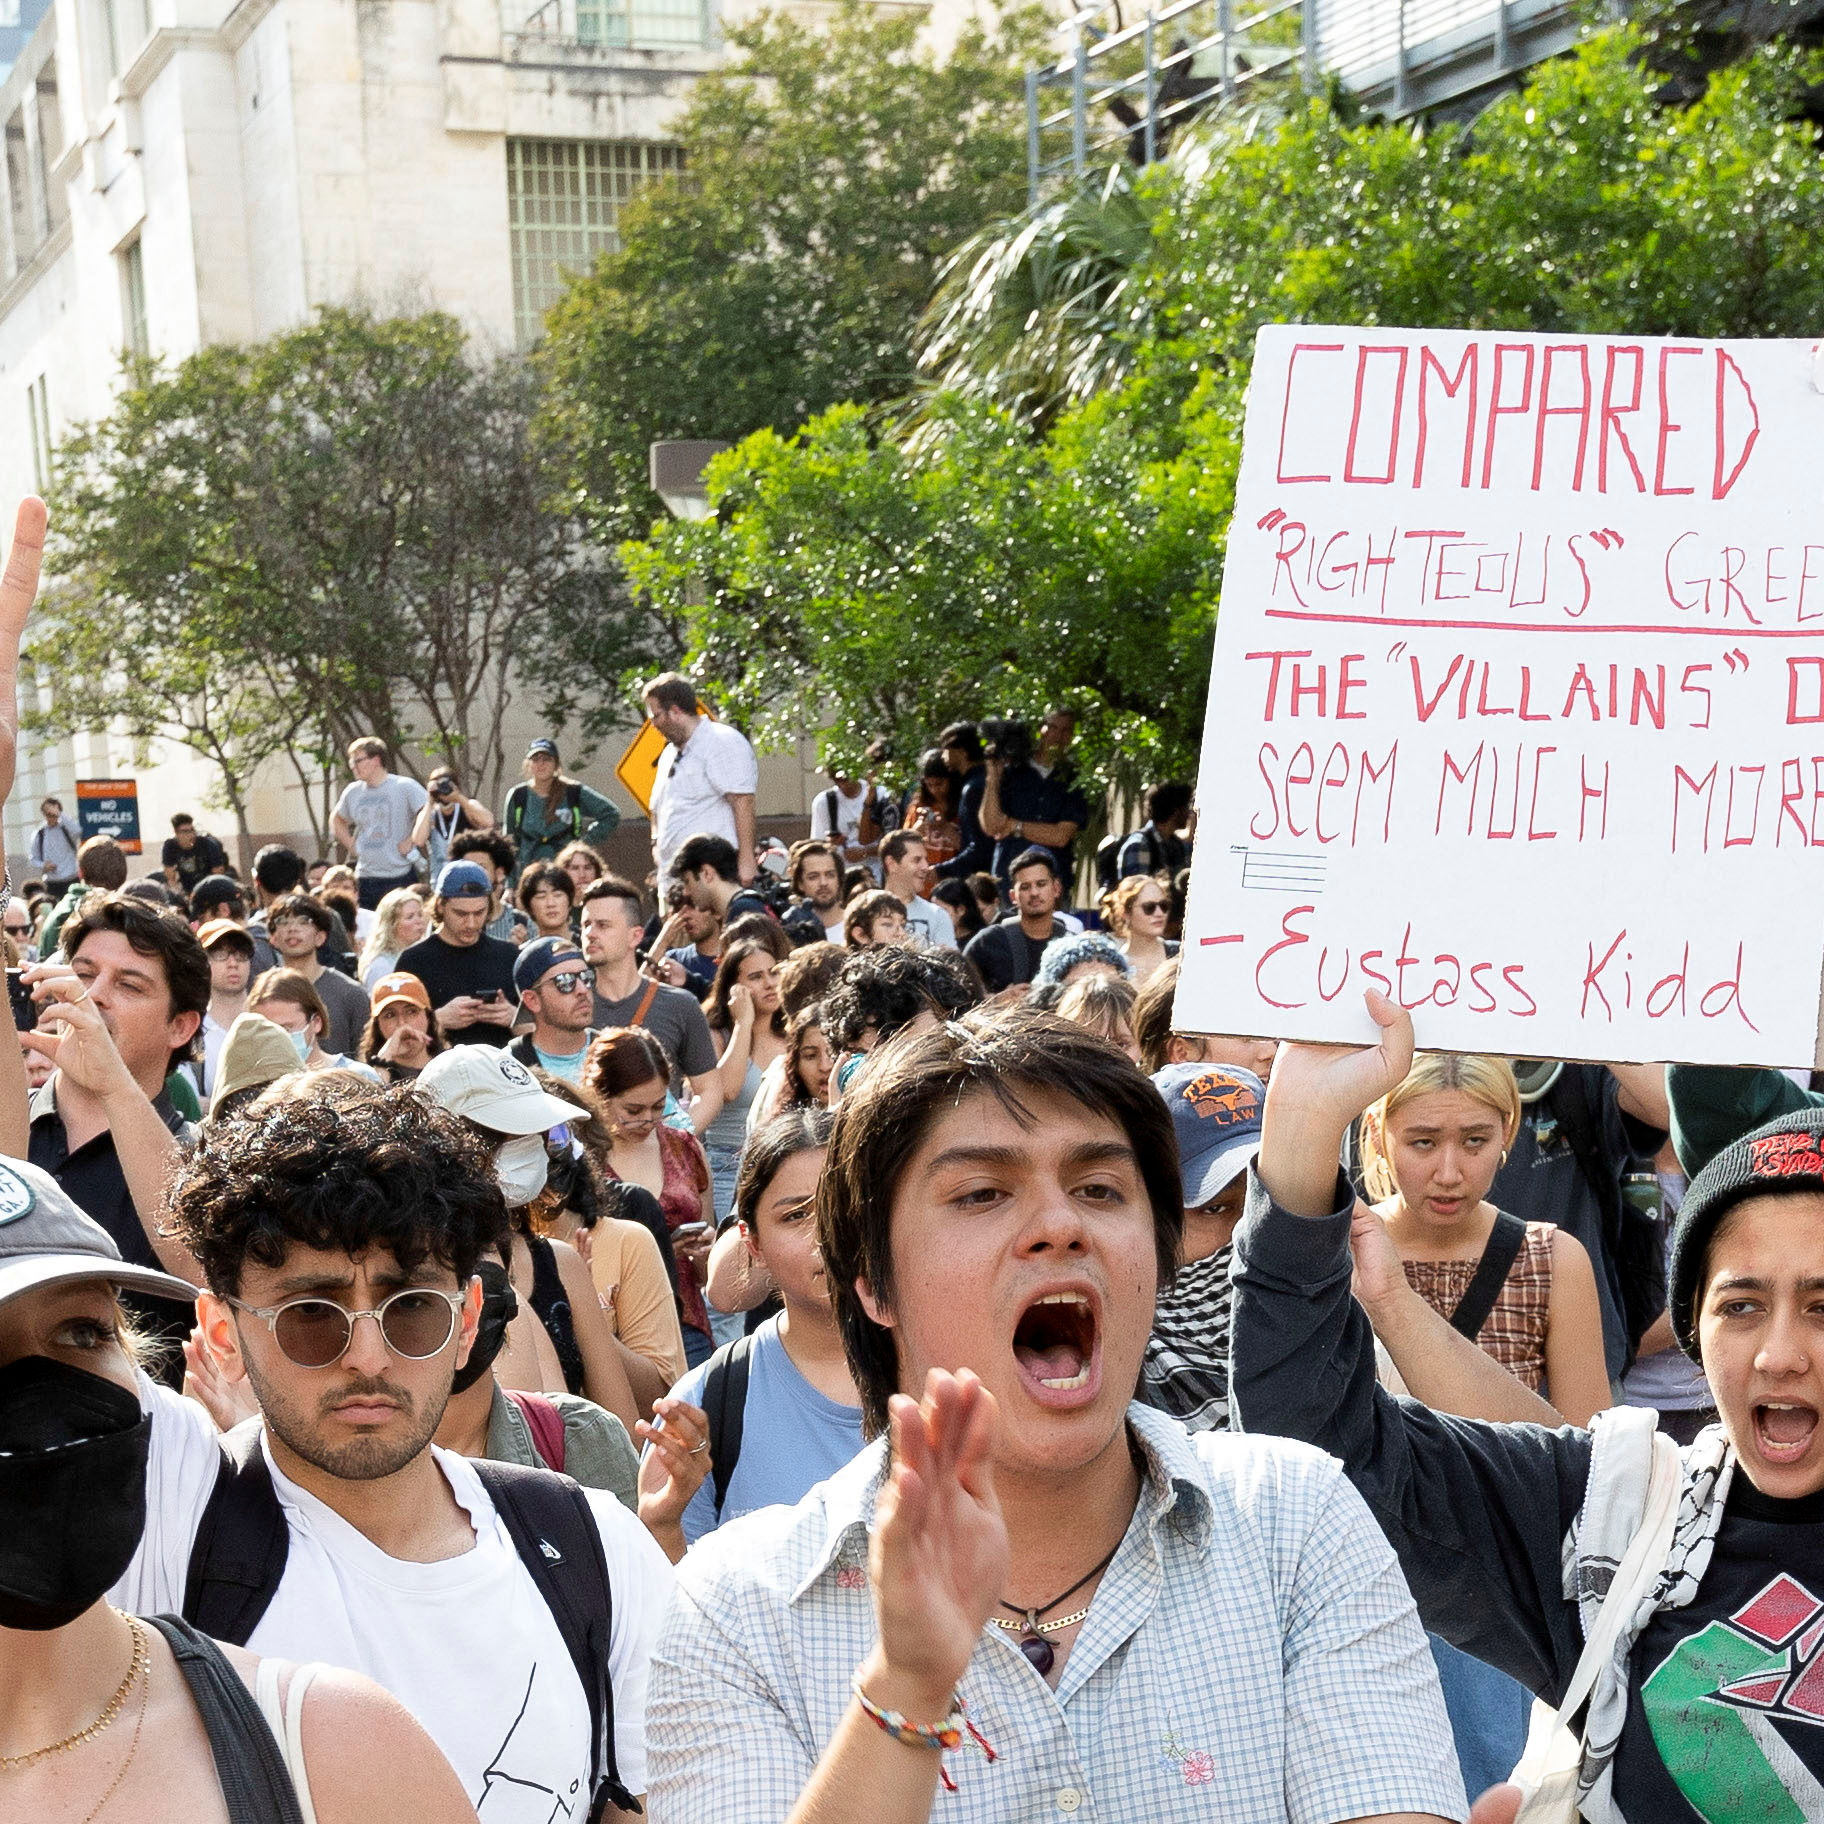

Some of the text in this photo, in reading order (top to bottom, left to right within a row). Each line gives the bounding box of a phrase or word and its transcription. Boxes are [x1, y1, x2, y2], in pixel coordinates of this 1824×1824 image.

[1277, 343, 1761, 499] COMPARED
[1256, 508, 1625, 618] "RIGHTEOUS"
[1245, 649, 1368, 722] THE
[1386, 641, 1750, 731] "VILLAINS"
[1436, 739, 1609, 842] MUCH
[1580, 928, 1761, 1034] Kidd
[1215, 1108, 1255, 1125] LAW
